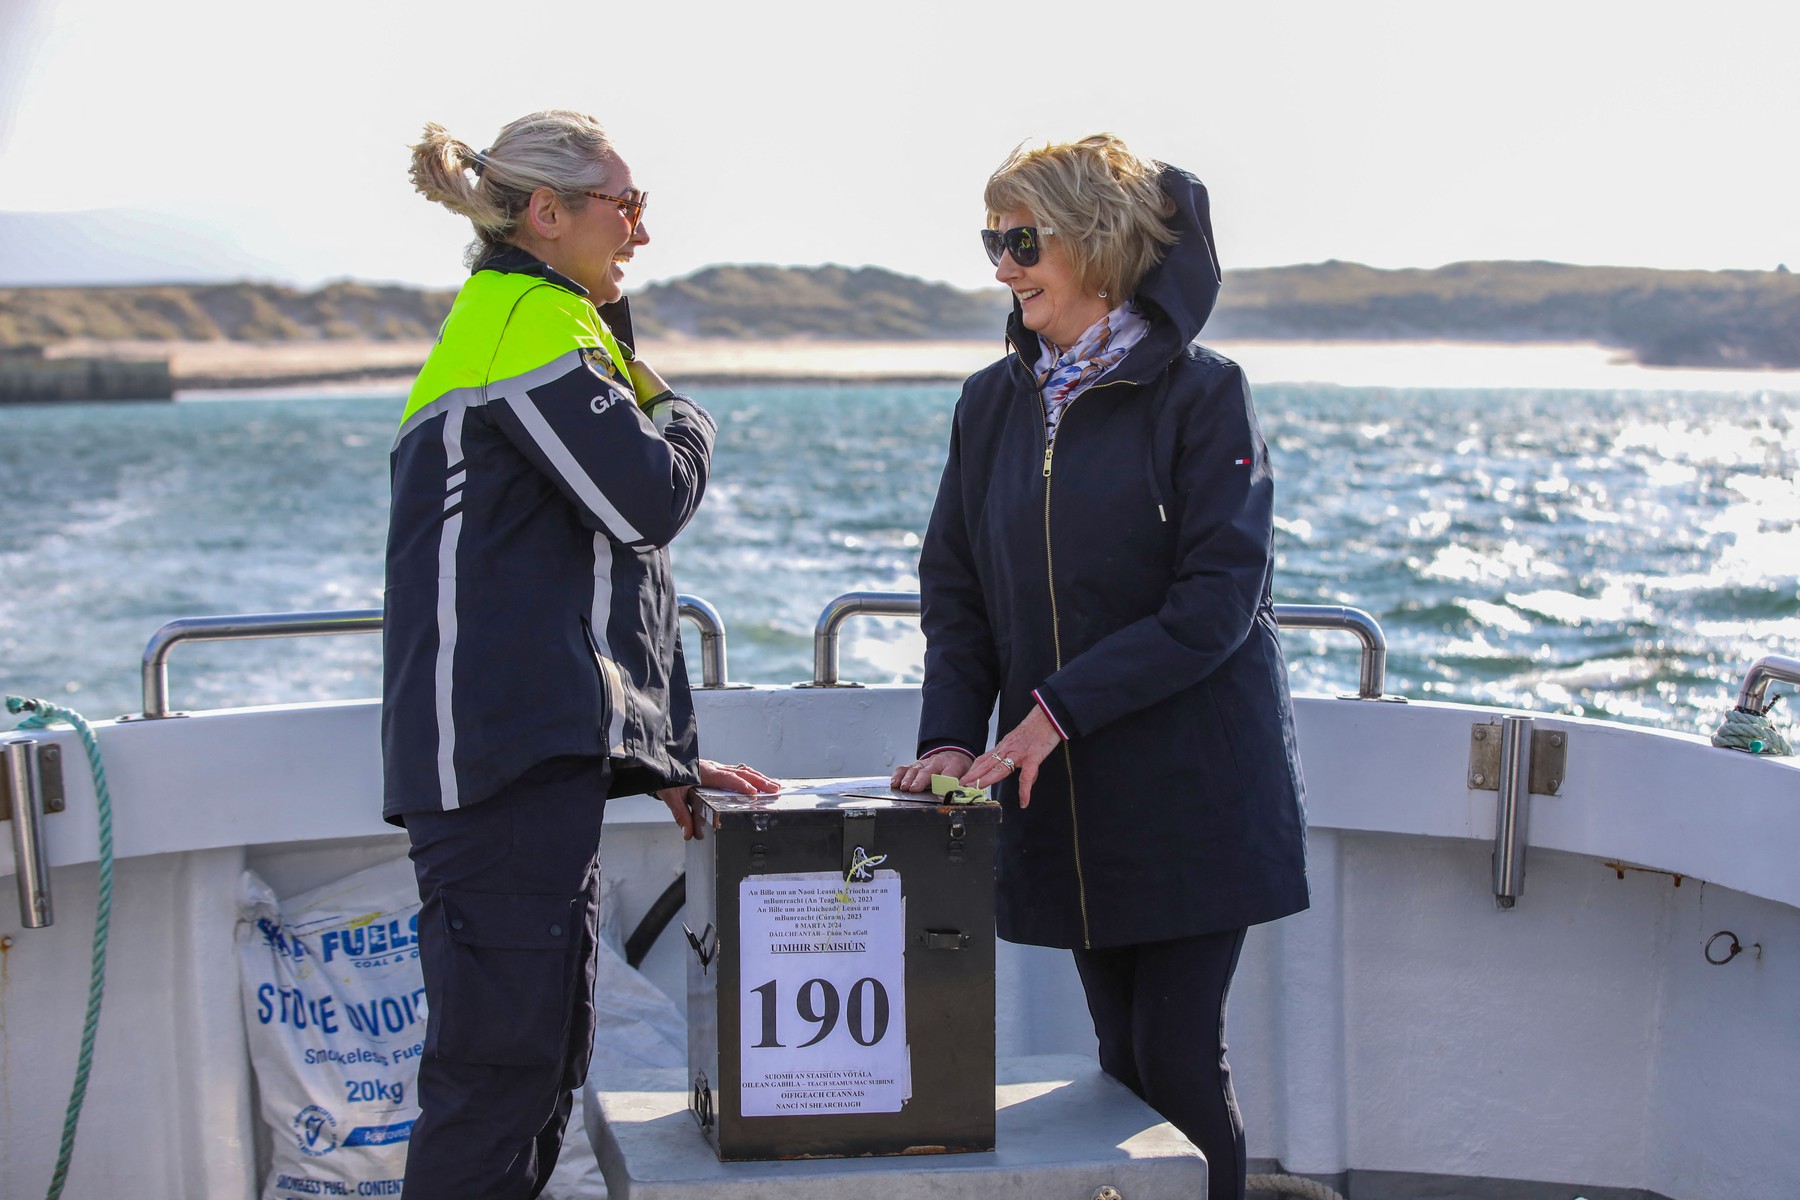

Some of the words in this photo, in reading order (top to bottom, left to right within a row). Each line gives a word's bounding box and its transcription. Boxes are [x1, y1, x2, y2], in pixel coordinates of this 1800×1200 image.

[590, 388, 625, 414] GA
[321, 912, 418, 963] FUELS
[771, 943, 811, 952] UIMHIR
[813, 940, 866, 952] STAISIÚIN
[354, 958, 389, 968] COAL
[750, 976, 890, 1048] 190
[304, 1047, 389, 1067] Smokeless
[393, 1040, 425, 1064] Fue
[806, 1071, 842, 1079] STAISIÚIN
[843, 1070, 872, 1078] VÓTÁLA
[345, 1079, 404, 1105] 20kg
[781, 1091, 824, 1099] OIFIGEACH
[809, 1101, 861, 1109] SHEARCHAIGH
[323, 1181, 349, 1196] FUEL
